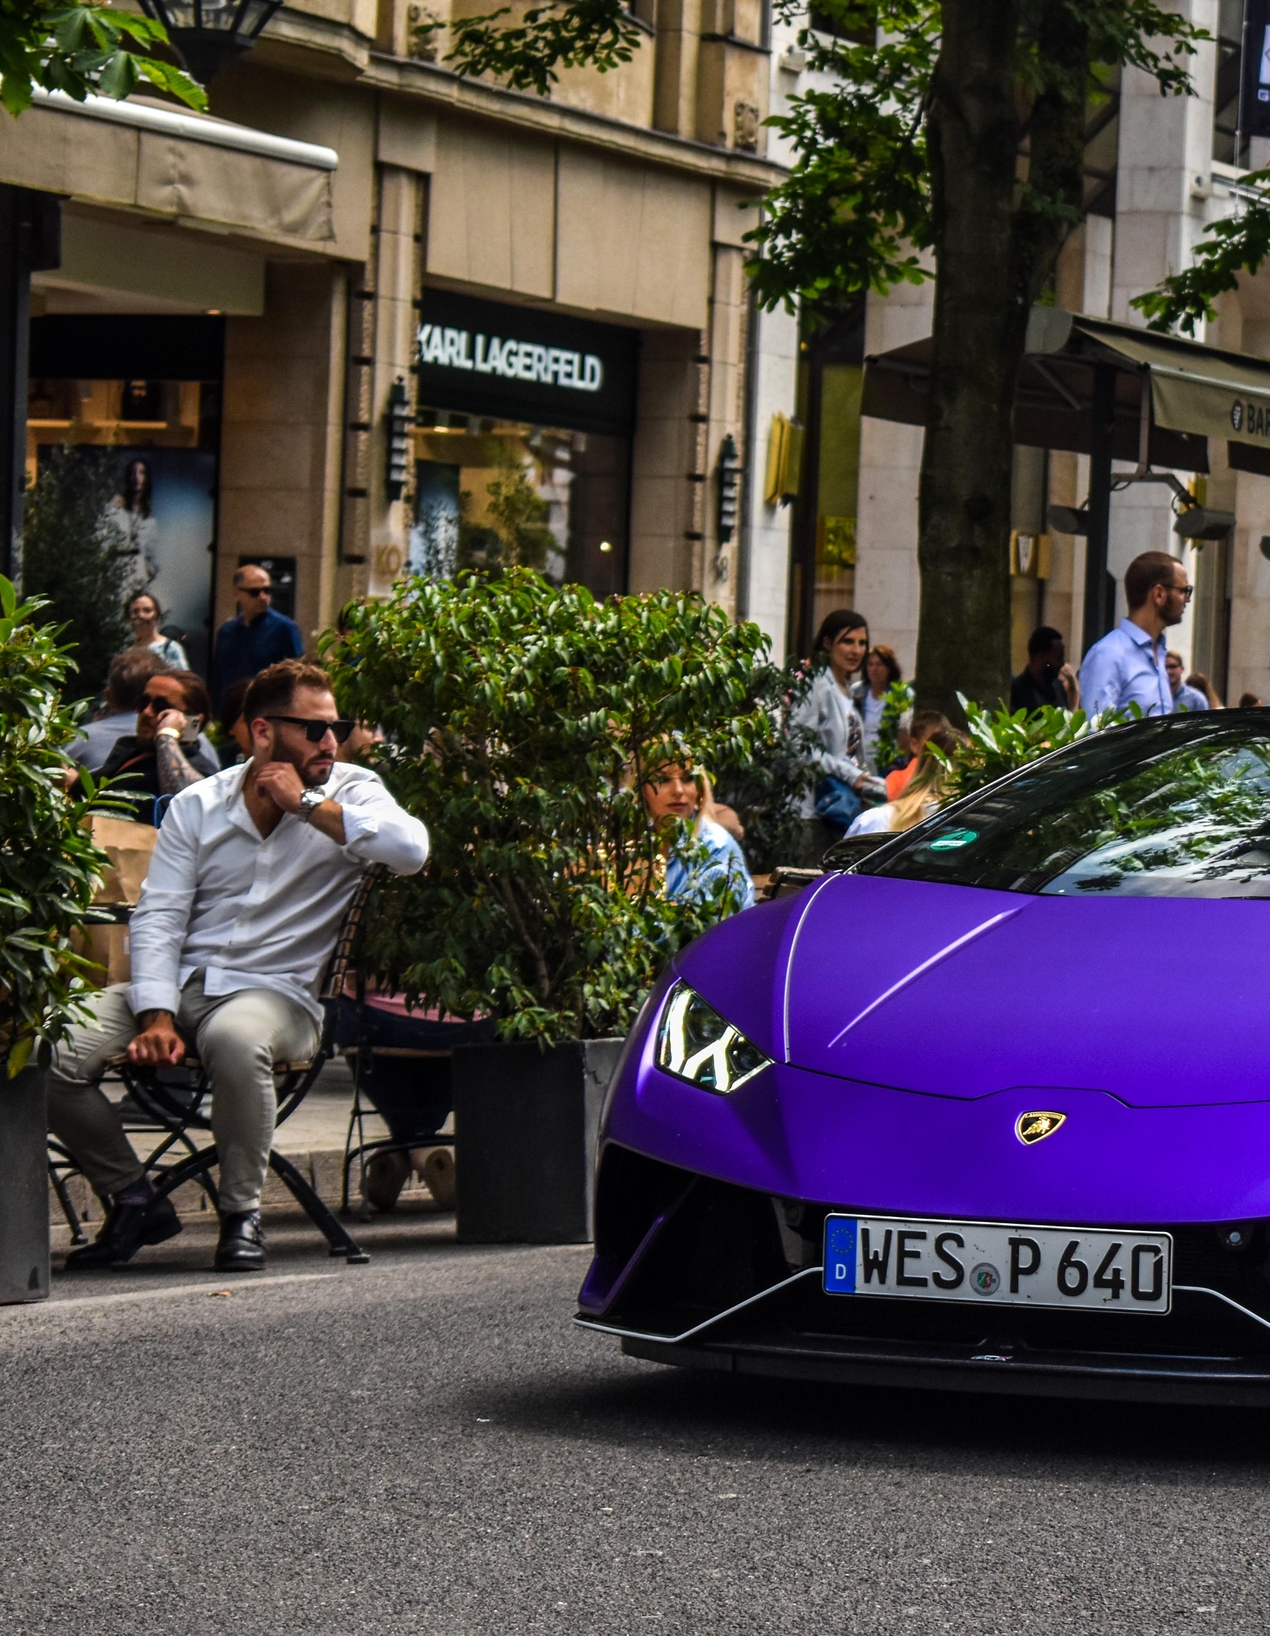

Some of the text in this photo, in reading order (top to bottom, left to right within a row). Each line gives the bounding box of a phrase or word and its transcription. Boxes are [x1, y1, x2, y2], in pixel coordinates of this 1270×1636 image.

[417, 323, 604, 391] KARL LAGERFELD
[835, 1263, 847, 1280] D
[861, 1227, 965, 1290] WES
[1008, 1237, 1041, 1294] P
[1057, 1239, 1164, 1301] 640
